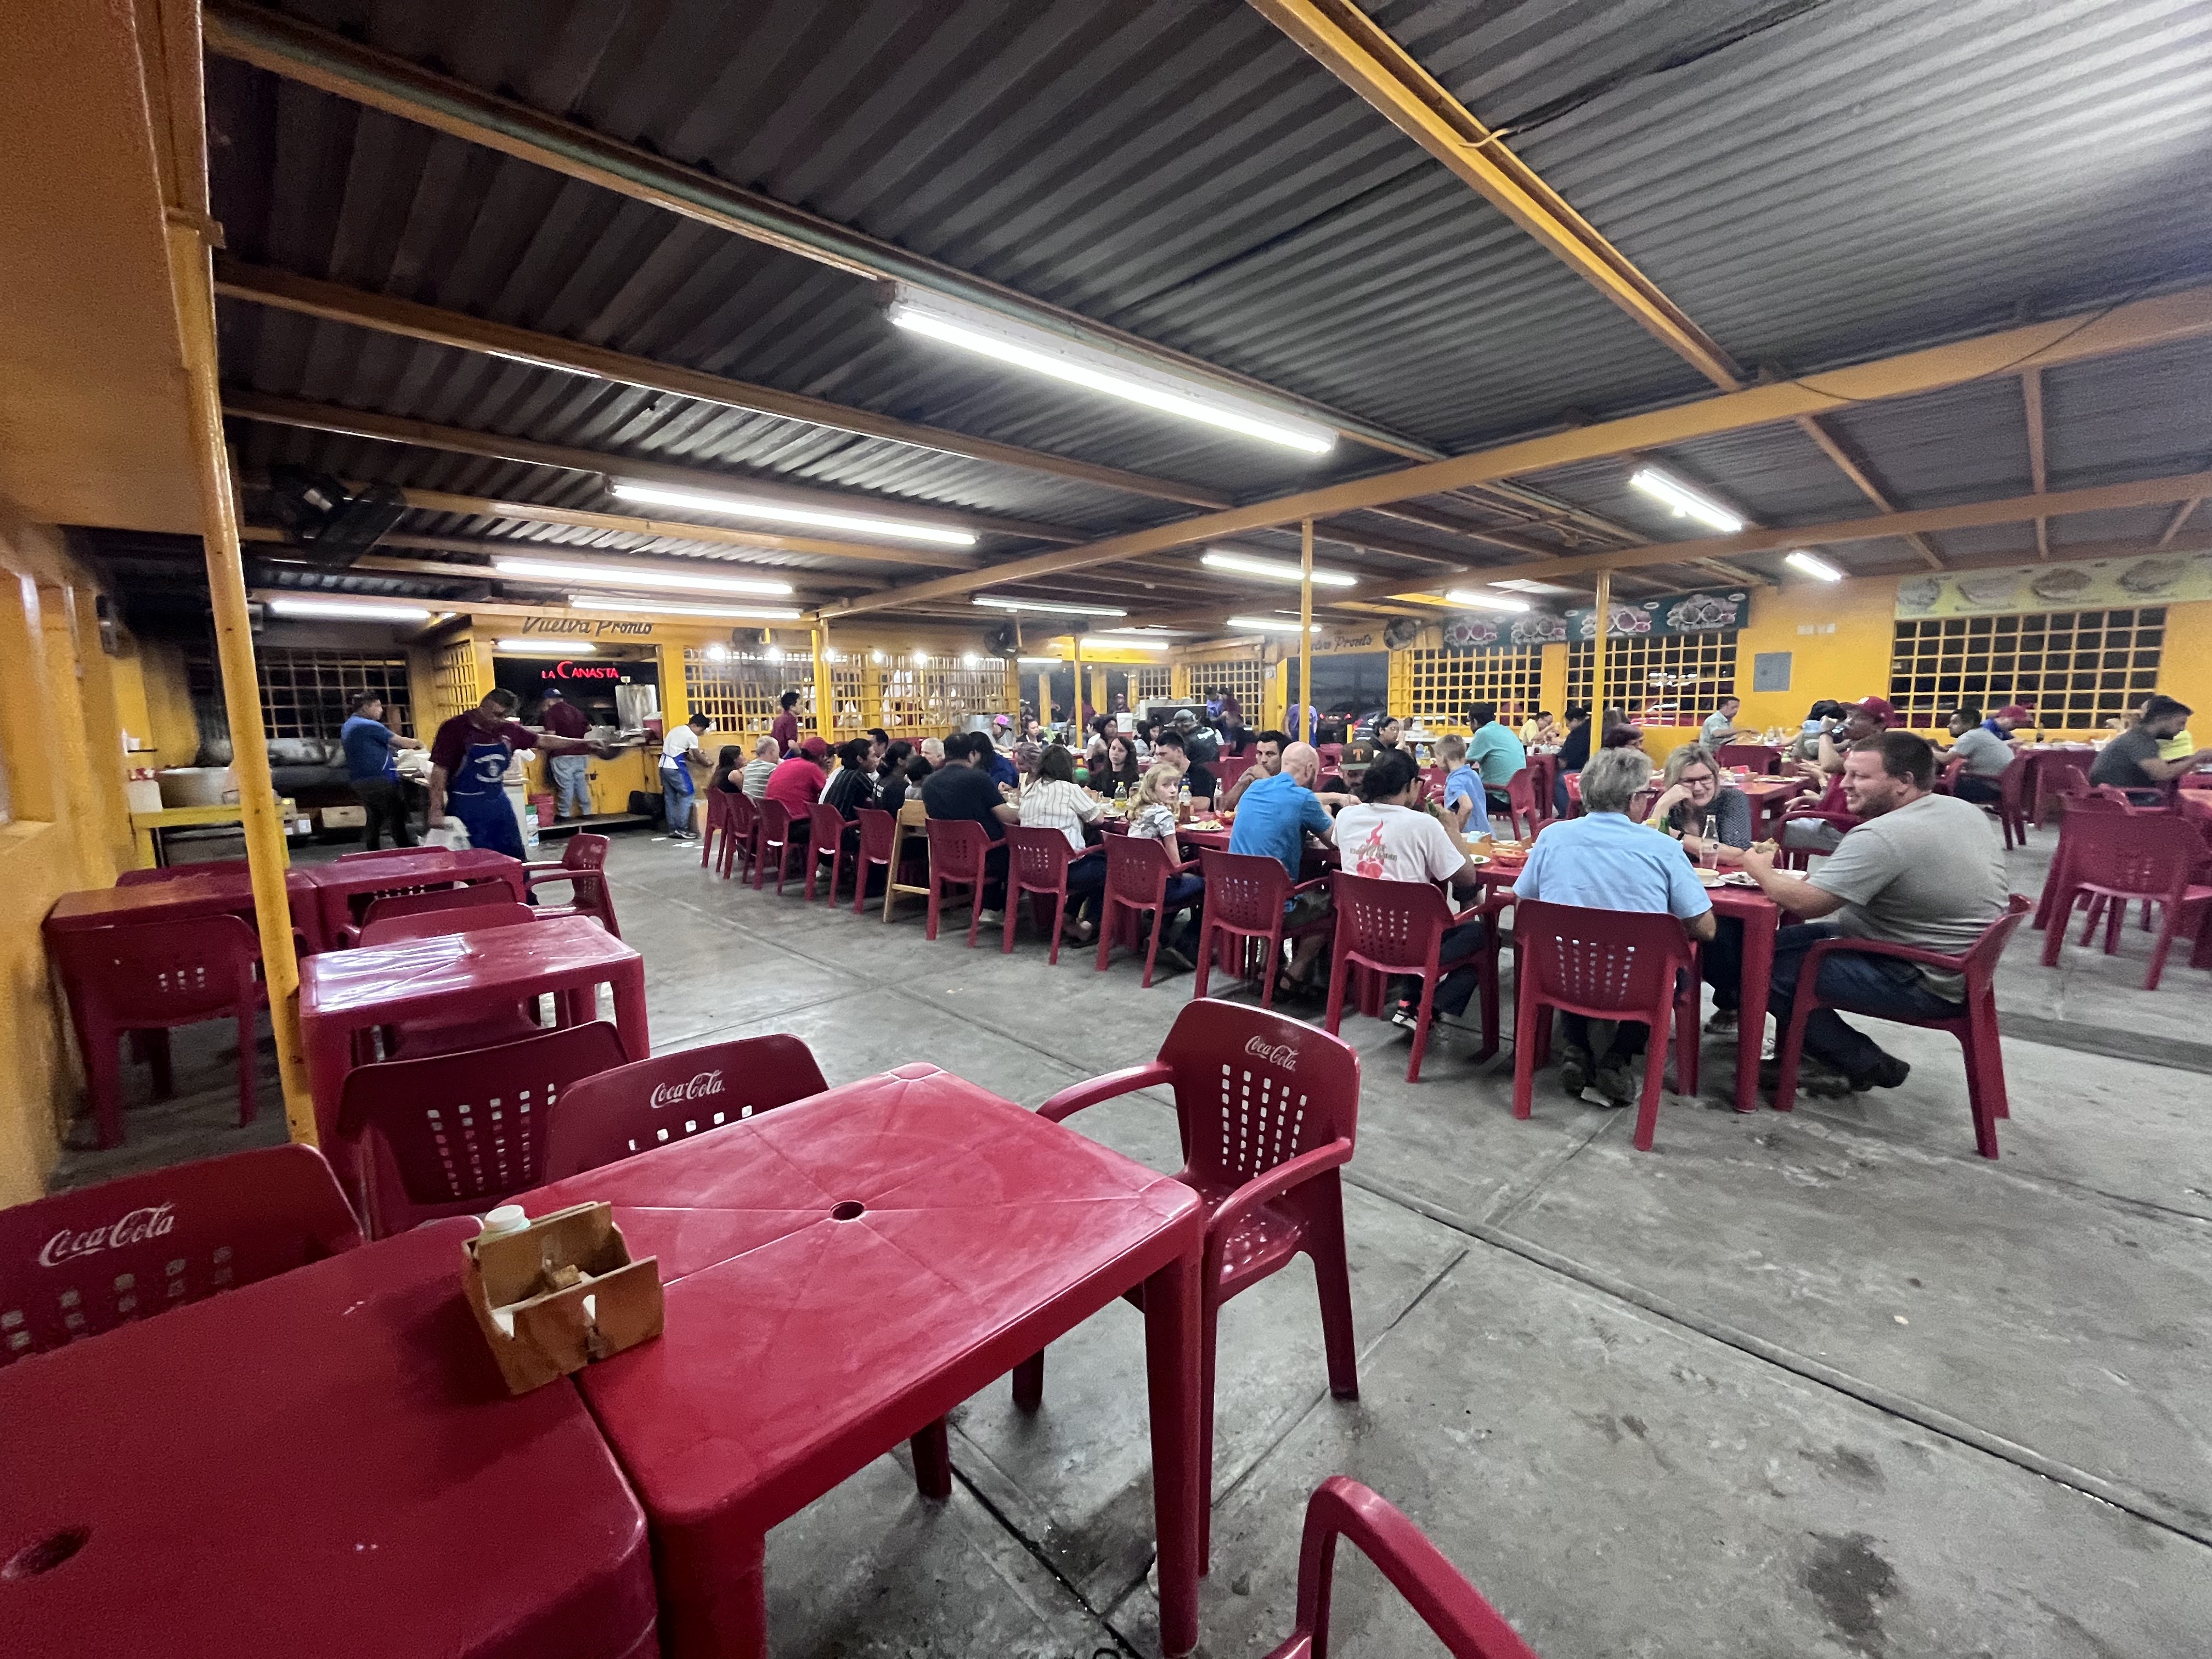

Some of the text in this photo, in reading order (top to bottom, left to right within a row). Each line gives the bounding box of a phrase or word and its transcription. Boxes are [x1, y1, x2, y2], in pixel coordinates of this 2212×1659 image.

[522, 616, 591, 634] Vuelva
[541, 670, 556, 679] LA
[1352, 748, 1364, 761] T
[1244, 1035, 1299, 1071] Coca-Cola
[650, 1070, 725, 1109] Coca-Cola
[38, 1201, 175, 1268] Coca-Cola
